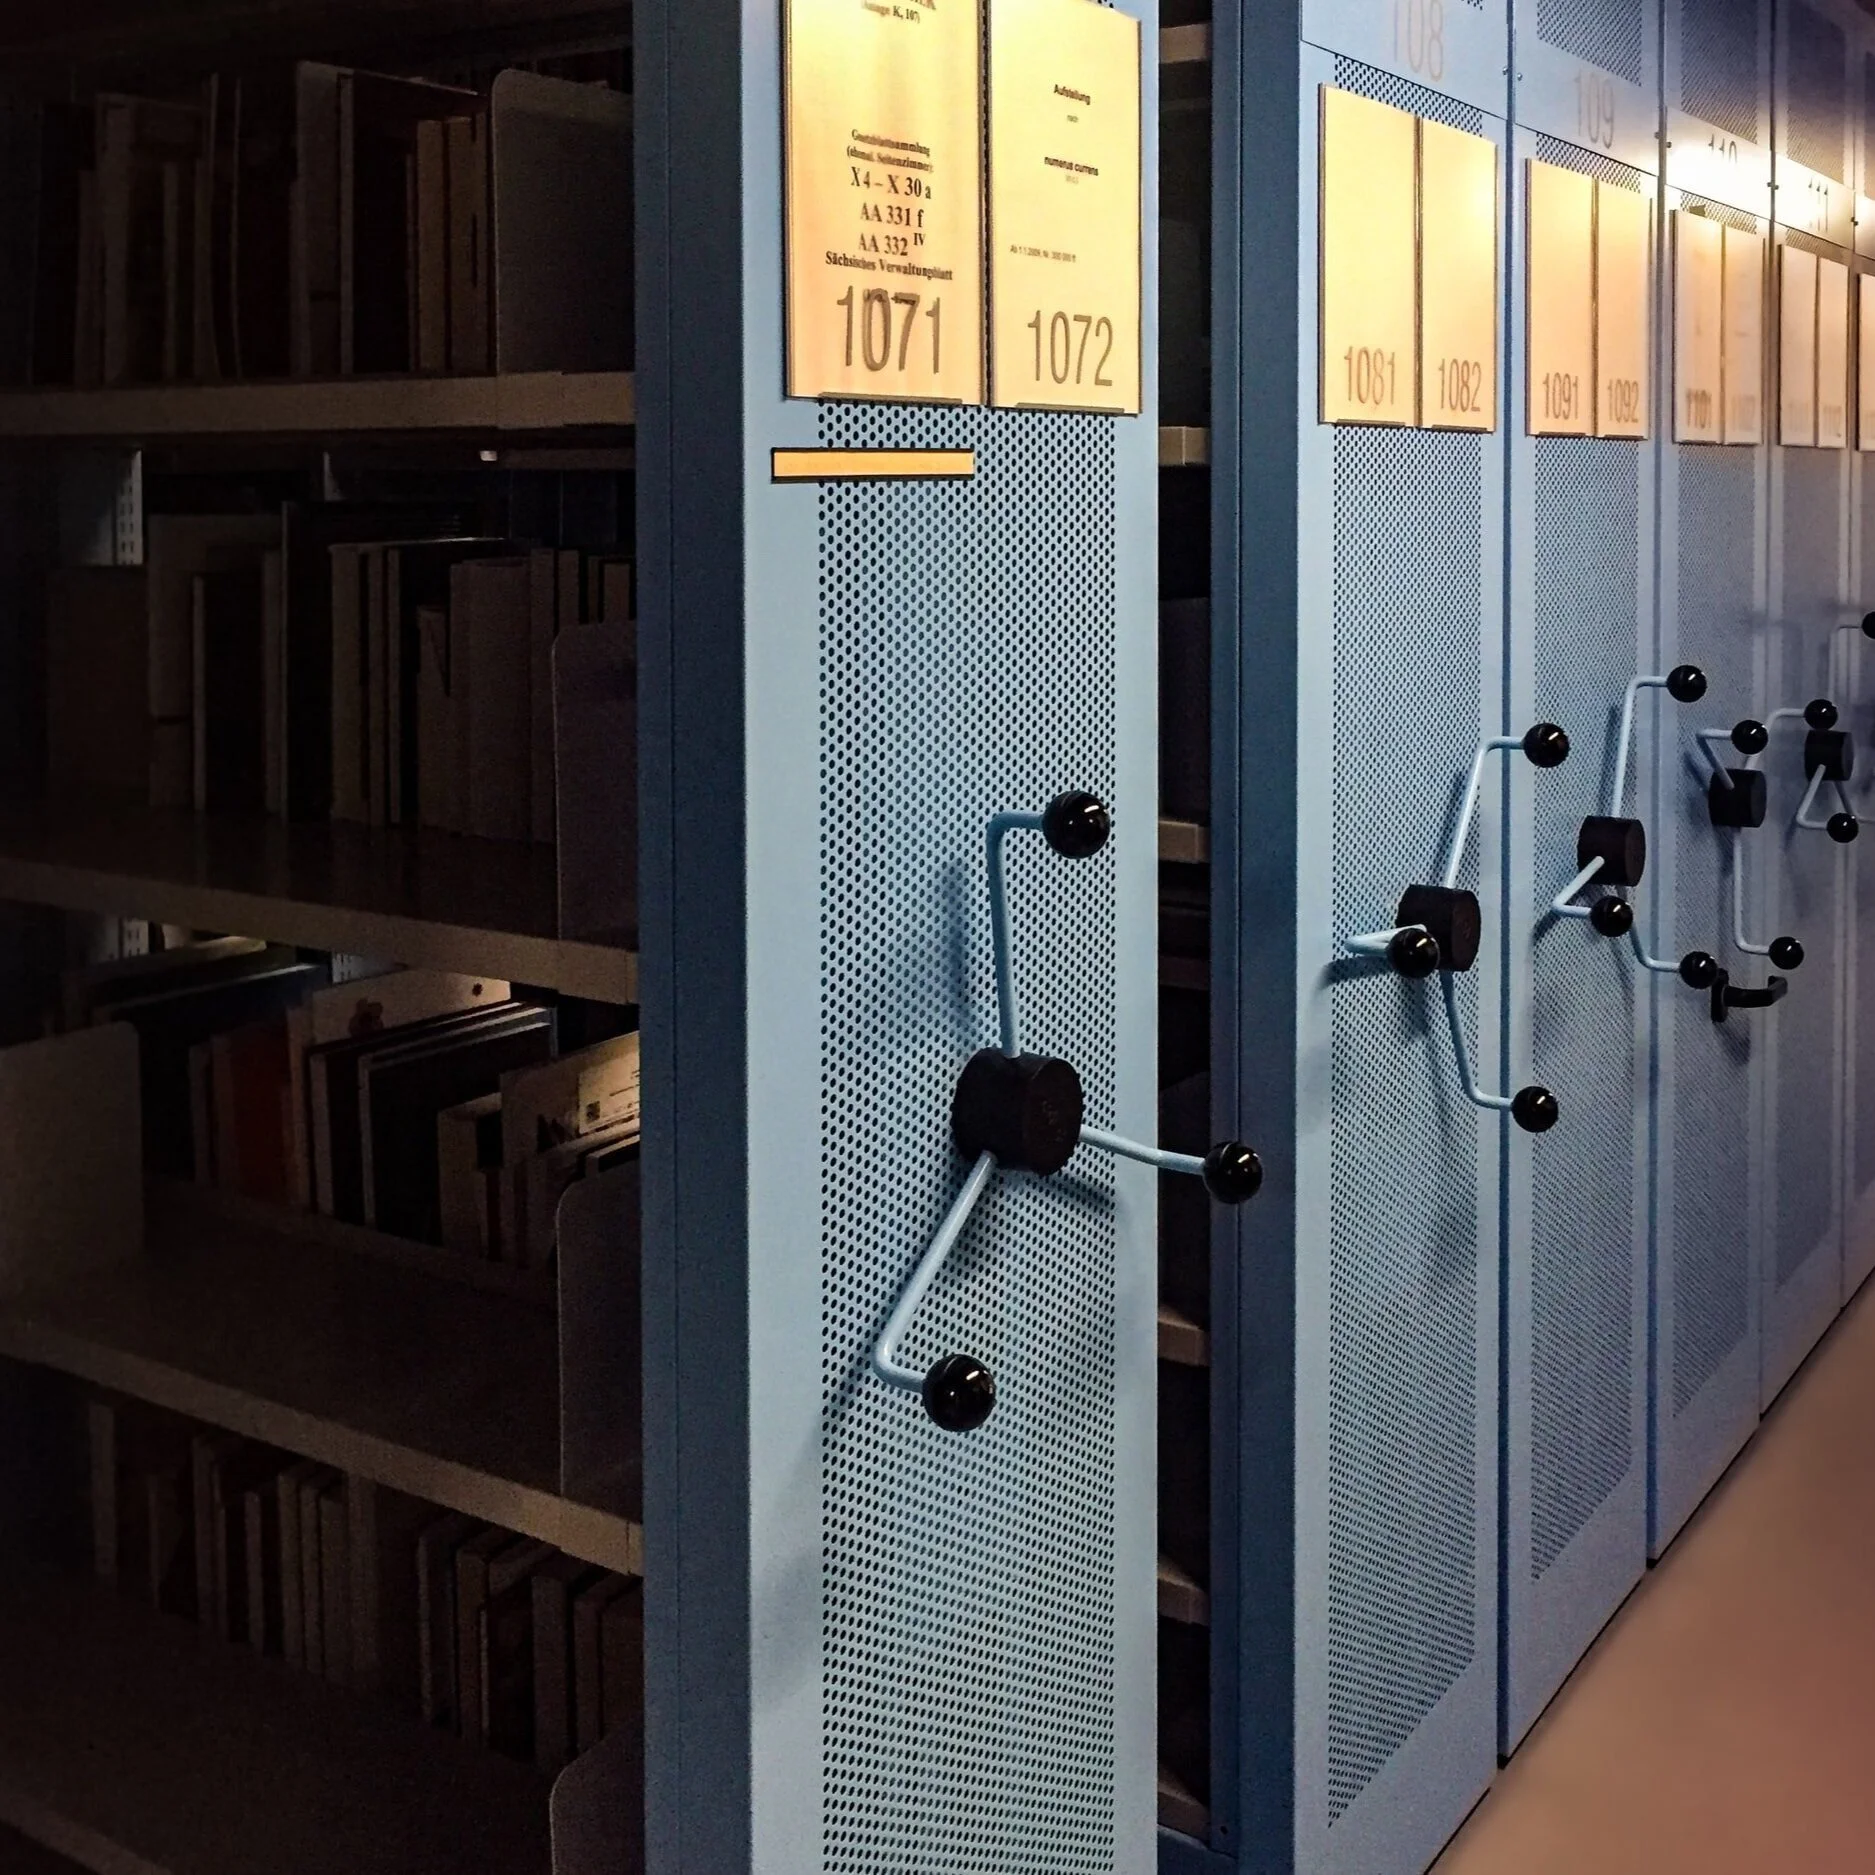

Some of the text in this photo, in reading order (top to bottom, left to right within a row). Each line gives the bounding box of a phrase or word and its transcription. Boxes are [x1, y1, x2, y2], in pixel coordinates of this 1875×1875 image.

[1573, 68, 1615, 149] 109
[887, 174, 899, 194] X
[904, 176, 922, 197] 30
[860, 202, 924, 228] AA 331 f
[858, 232, 926, 256] AA 332 IV
[837, 285, 940, 374] 1071
[1028, 310, 1113, 386] 1072
[1344, 345, 1395, 405] 1081
[1438, 358, 1481, 412] 1082
[1542, 372, 1579, 420] 1091
[1607, 377, 1639, 423] 1092
